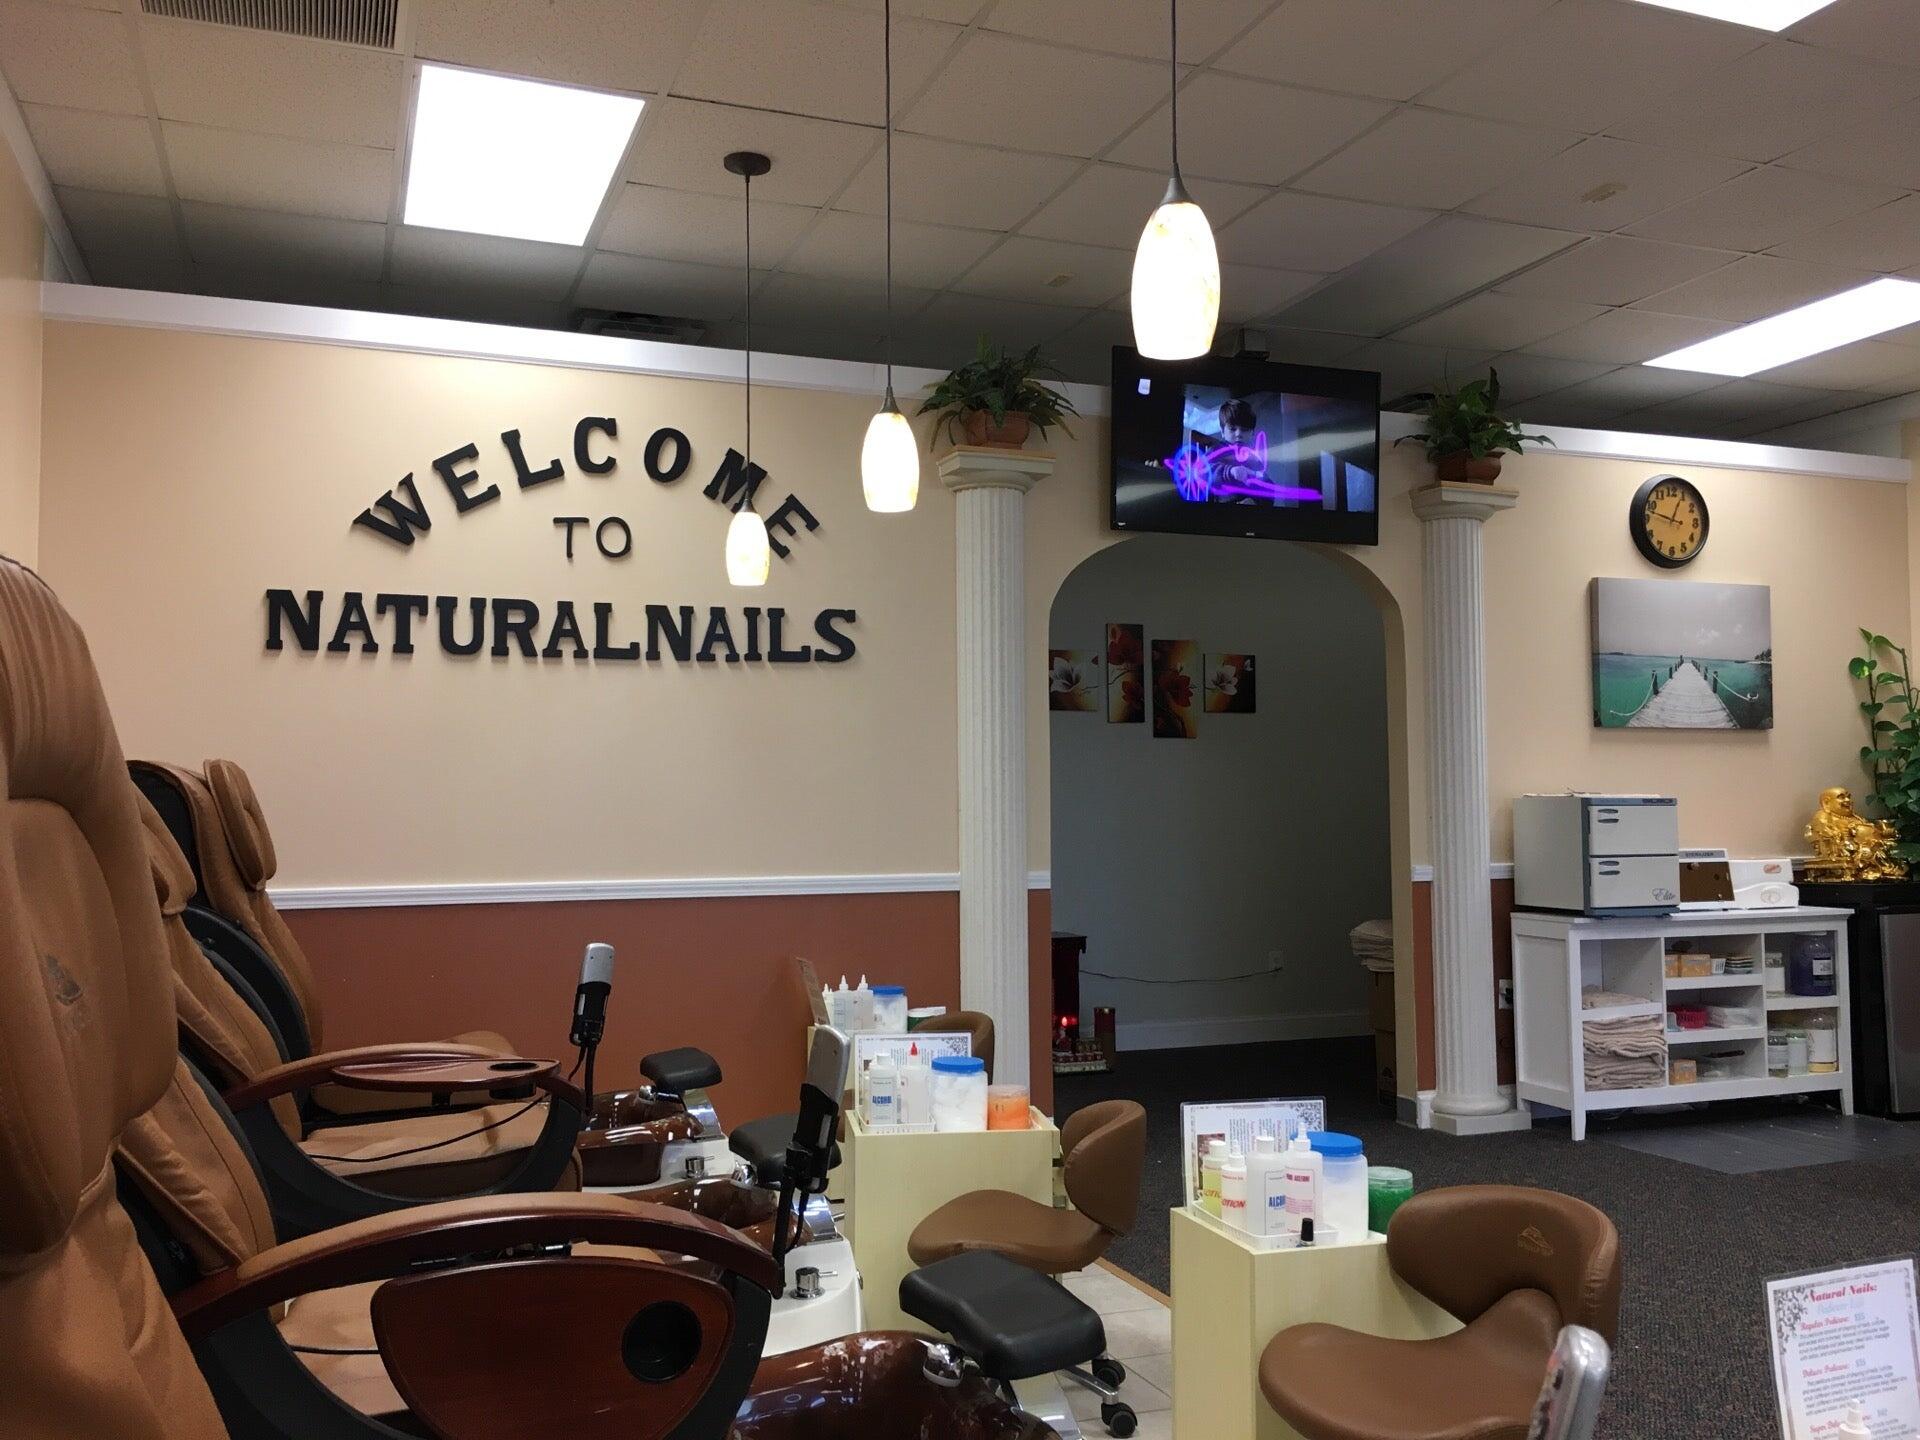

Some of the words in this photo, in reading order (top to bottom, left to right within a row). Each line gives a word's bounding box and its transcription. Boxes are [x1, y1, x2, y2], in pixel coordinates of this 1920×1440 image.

[353, 416, 818, 558] WELCOME
[553, 516, 632, 558] TO
[266, 589, 857, 663] NATURALNAILS
[872, 1096, 892, 1104] ALCOHOL
[1221, 1199, 1246, 1208] OTION
